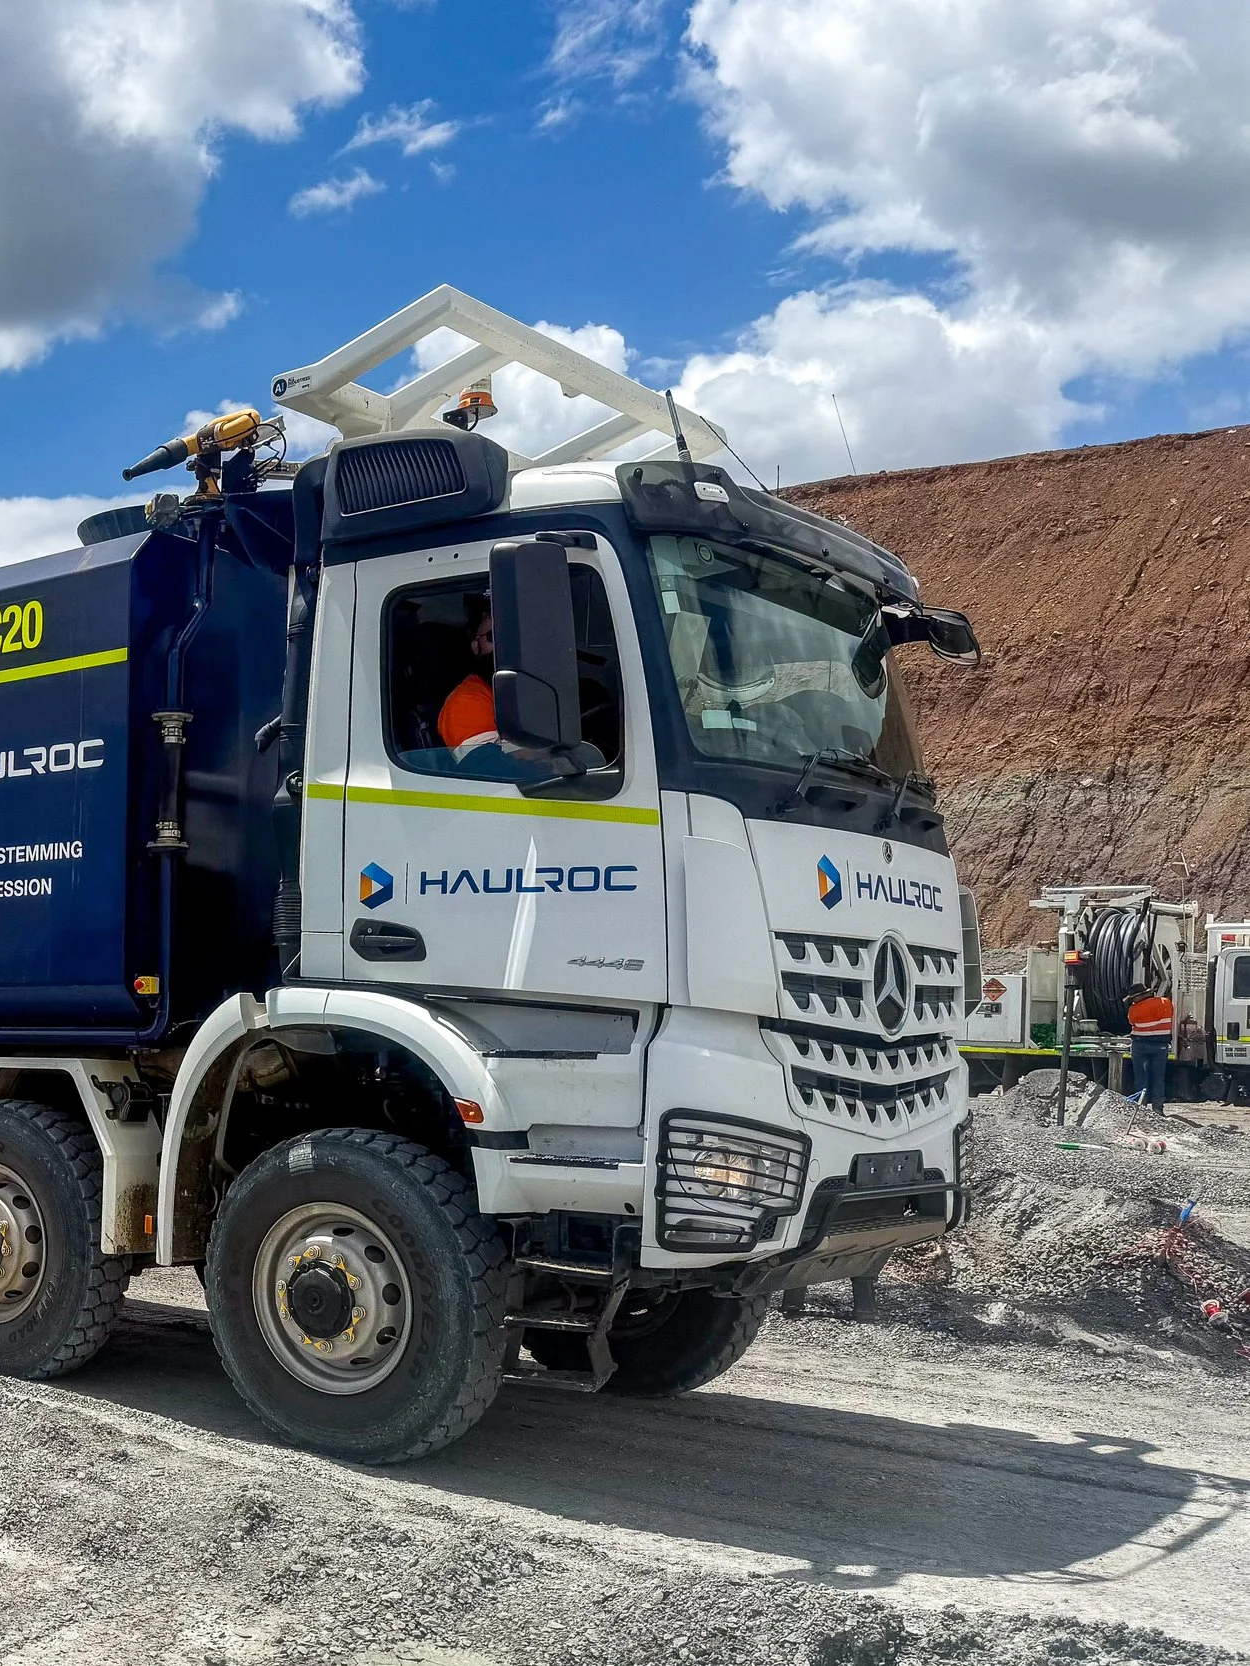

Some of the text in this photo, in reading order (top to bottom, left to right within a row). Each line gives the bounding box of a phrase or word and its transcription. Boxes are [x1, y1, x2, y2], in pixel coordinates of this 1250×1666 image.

[419, 865, 638, 895] HAULROC
[856, 871, 943, 913] HAULROC
[371, 1198, 435, 1380] GOODYEAR
